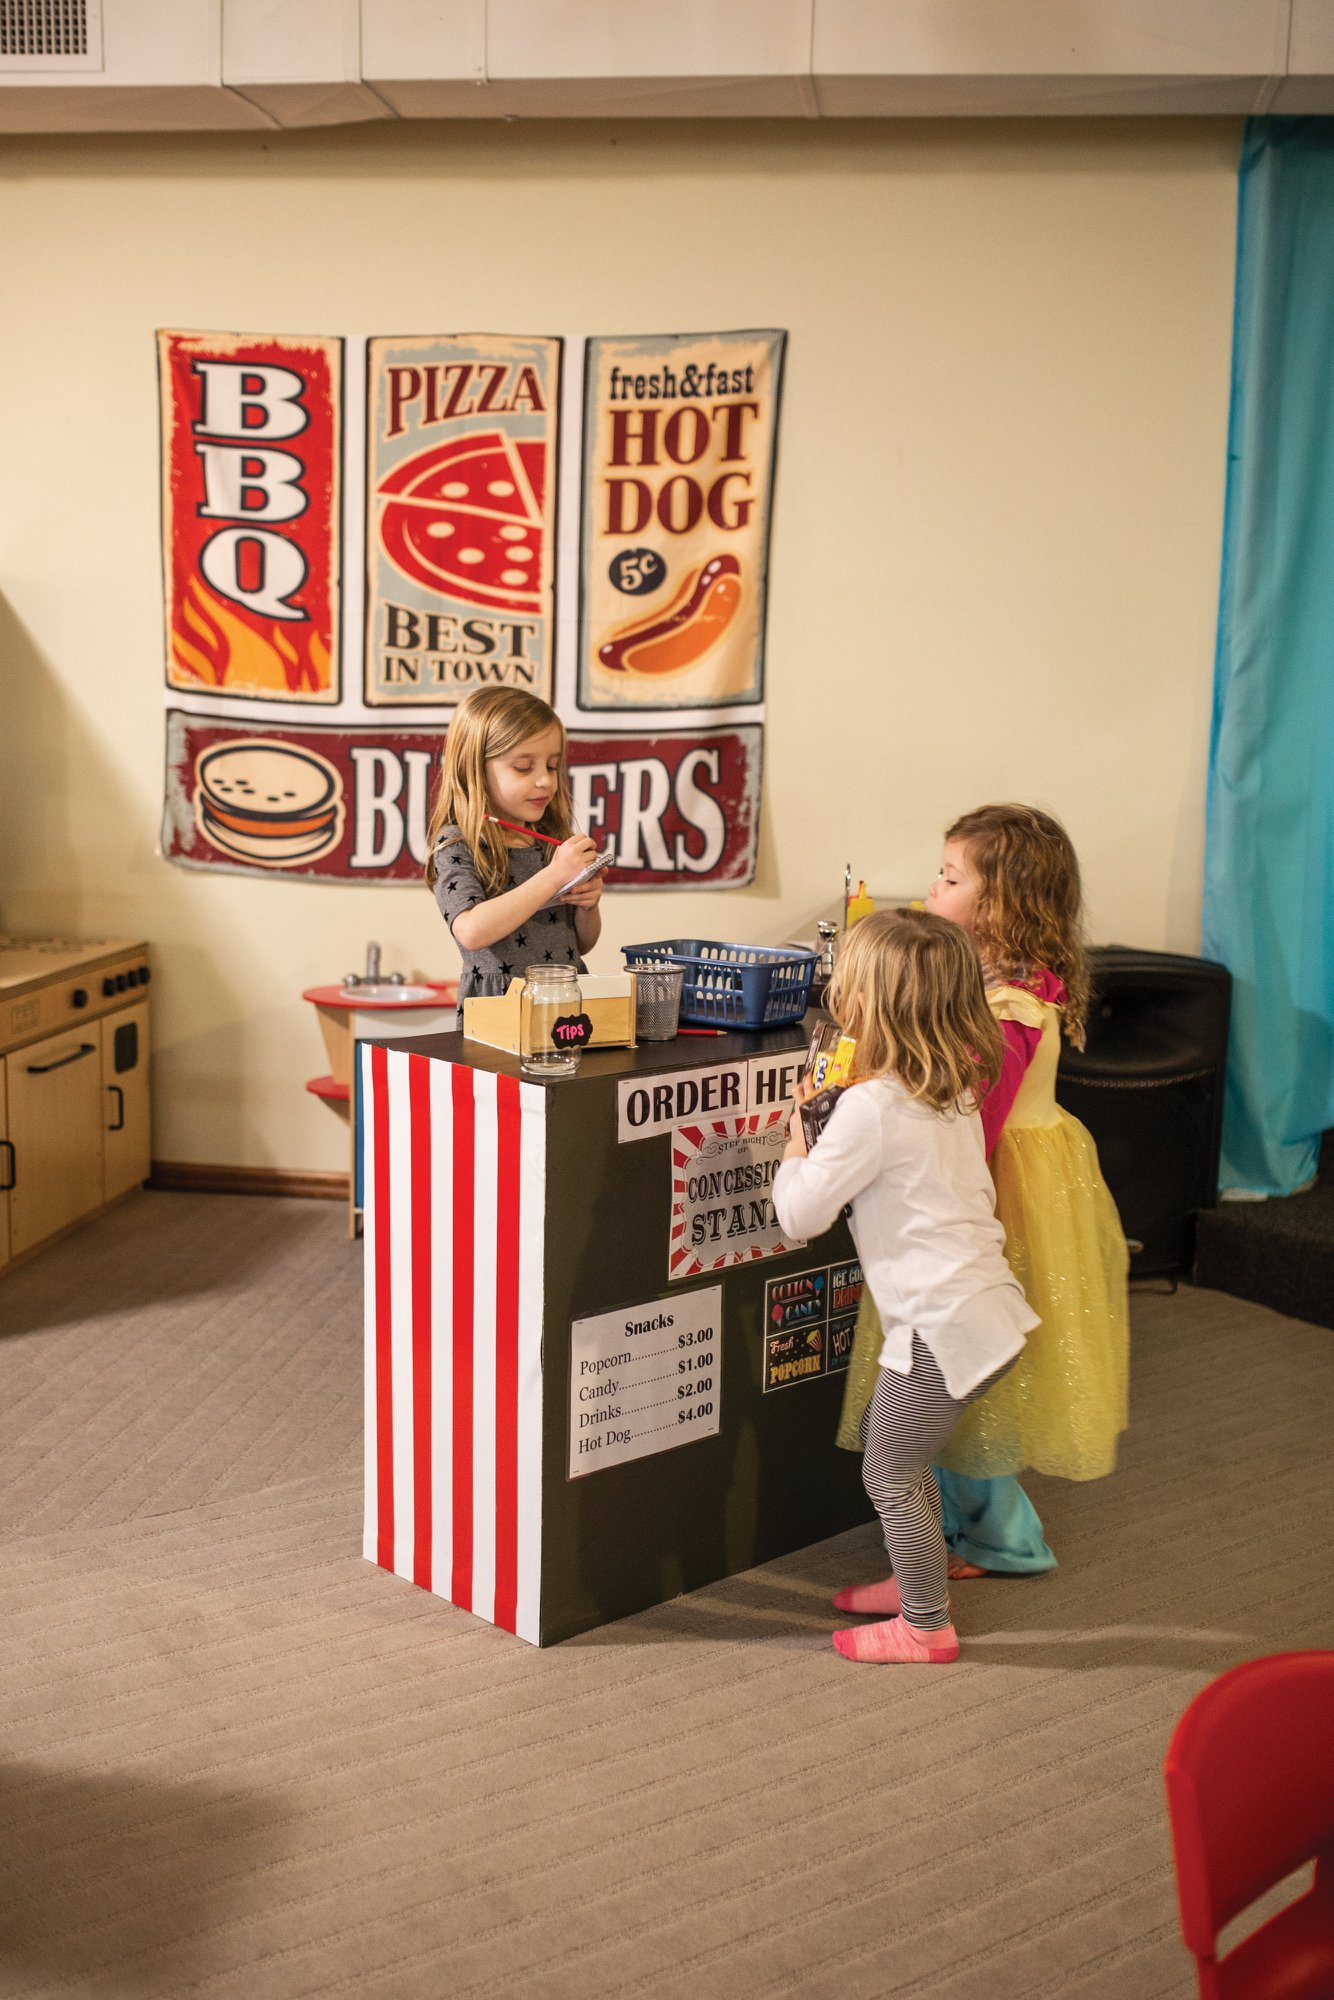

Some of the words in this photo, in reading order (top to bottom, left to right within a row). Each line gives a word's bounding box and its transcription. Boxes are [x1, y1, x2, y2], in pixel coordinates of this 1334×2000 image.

[610, 362, 754, 400] fresh&fast
[386, 364, 547, 438] PIZZA
[607, 402, 759, 467] HOT
[191, 358, 312, 622] BBQ
[603, 472, 755, 536] DOG
[384, 602, 536, 658] BEST
[384, 657, 418, 683] IN
[431, 658, 537, 685] TOWN
[349, 746, 727, 873] BUERS
[813, 1057, 829, 1090] OTS
[626, 1071, 740, 1126] ORDER
[756, 1064, 805, 1105] HE
[718, 1139, 741, 1155] STEP
[742, 1135, 768, 1147] RIGHT
[737, 1146, 749, 1155] UP
[688, 1158, 782, 1204] CONCESSIO
[691, 1198, 781, 1247] STAN
[833, 1269, 847, 1289] ICE
[624, 1314, 674, 1337] Snacks
[678, 1327, 713, 1349] $3.00
[832, 1328, 852, 1356] HOT
[769, 1336, 794, 1354] Fresh
[678, 1352, 713, 1375] $1.00
[769, 1354, 821, 1384] POPCORN
[677, 1377, 713, 1400] $2.00
[578, 1437, 602, 1454] Hot
[677, 1402, 713, 1424] $4.00
